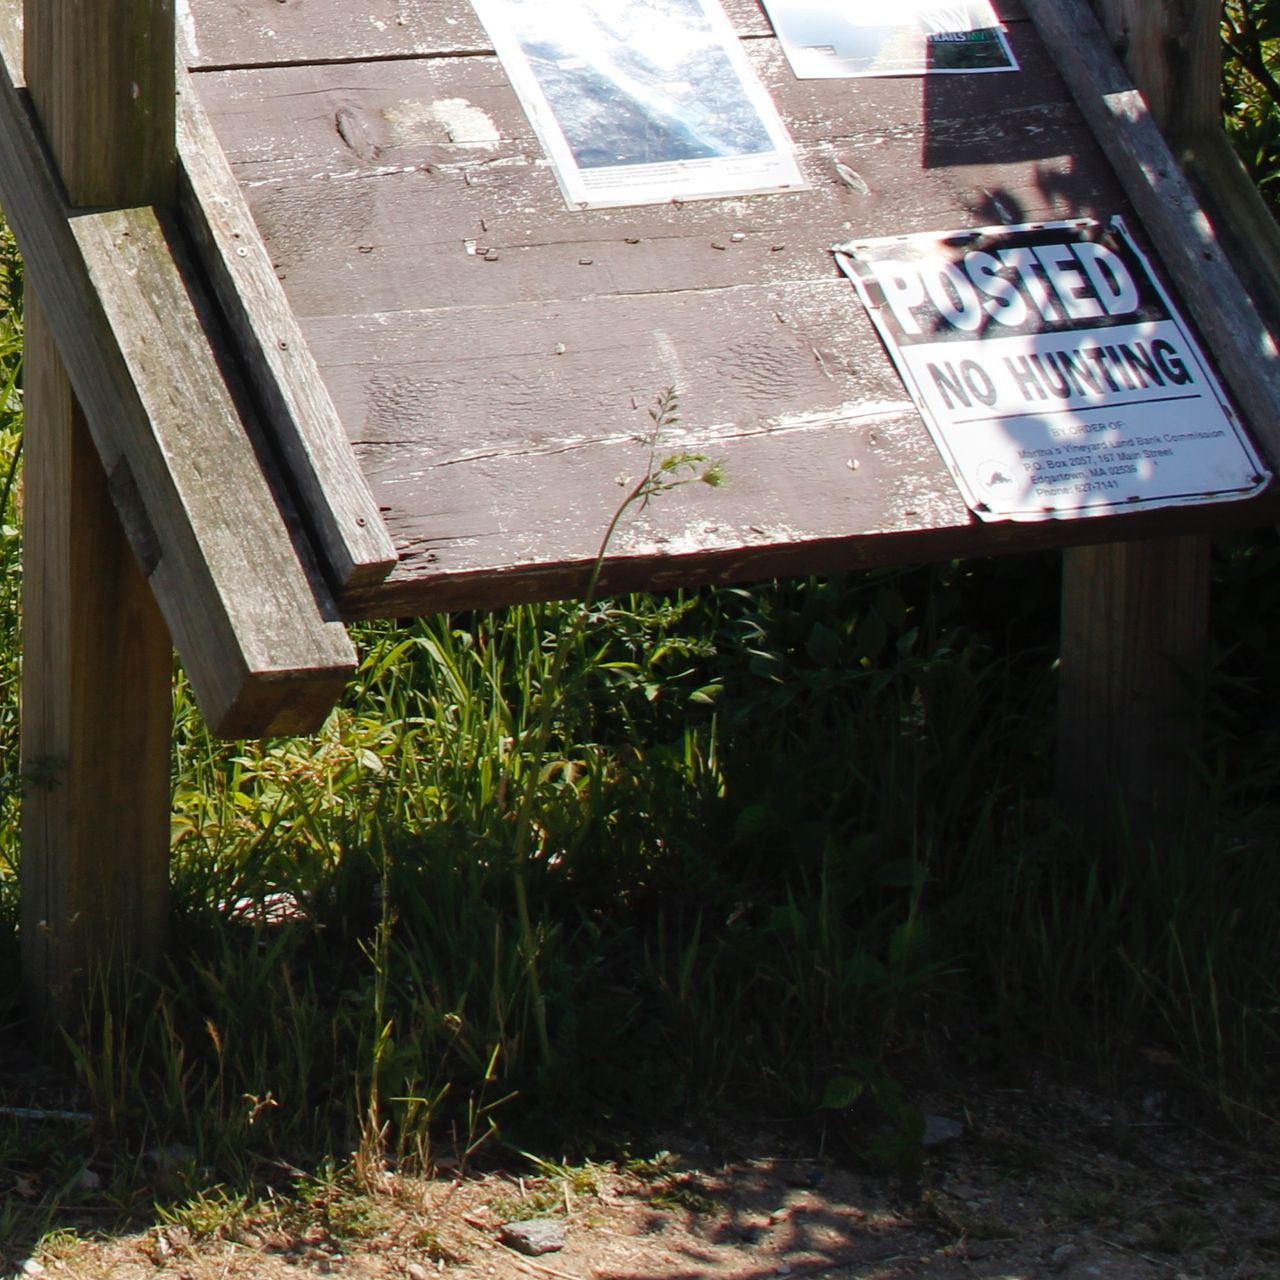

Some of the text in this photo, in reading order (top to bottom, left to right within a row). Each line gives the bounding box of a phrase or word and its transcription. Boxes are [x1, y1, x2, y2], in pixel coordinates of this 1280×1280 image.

[868, 242, 1139, 335] POSTED
[927, 338, 1194, 410] NO HUNTING
[1064, 440, 1108, 455] Vineyard
[1137, 434, 1161, 446] Bank
[1163, 428, 1226, 443] Commission
[1071, 423, 1107, 435] ORDER
[1046, 458, 1067, 469] Box
[1144, 447, 1174, 459] Street
